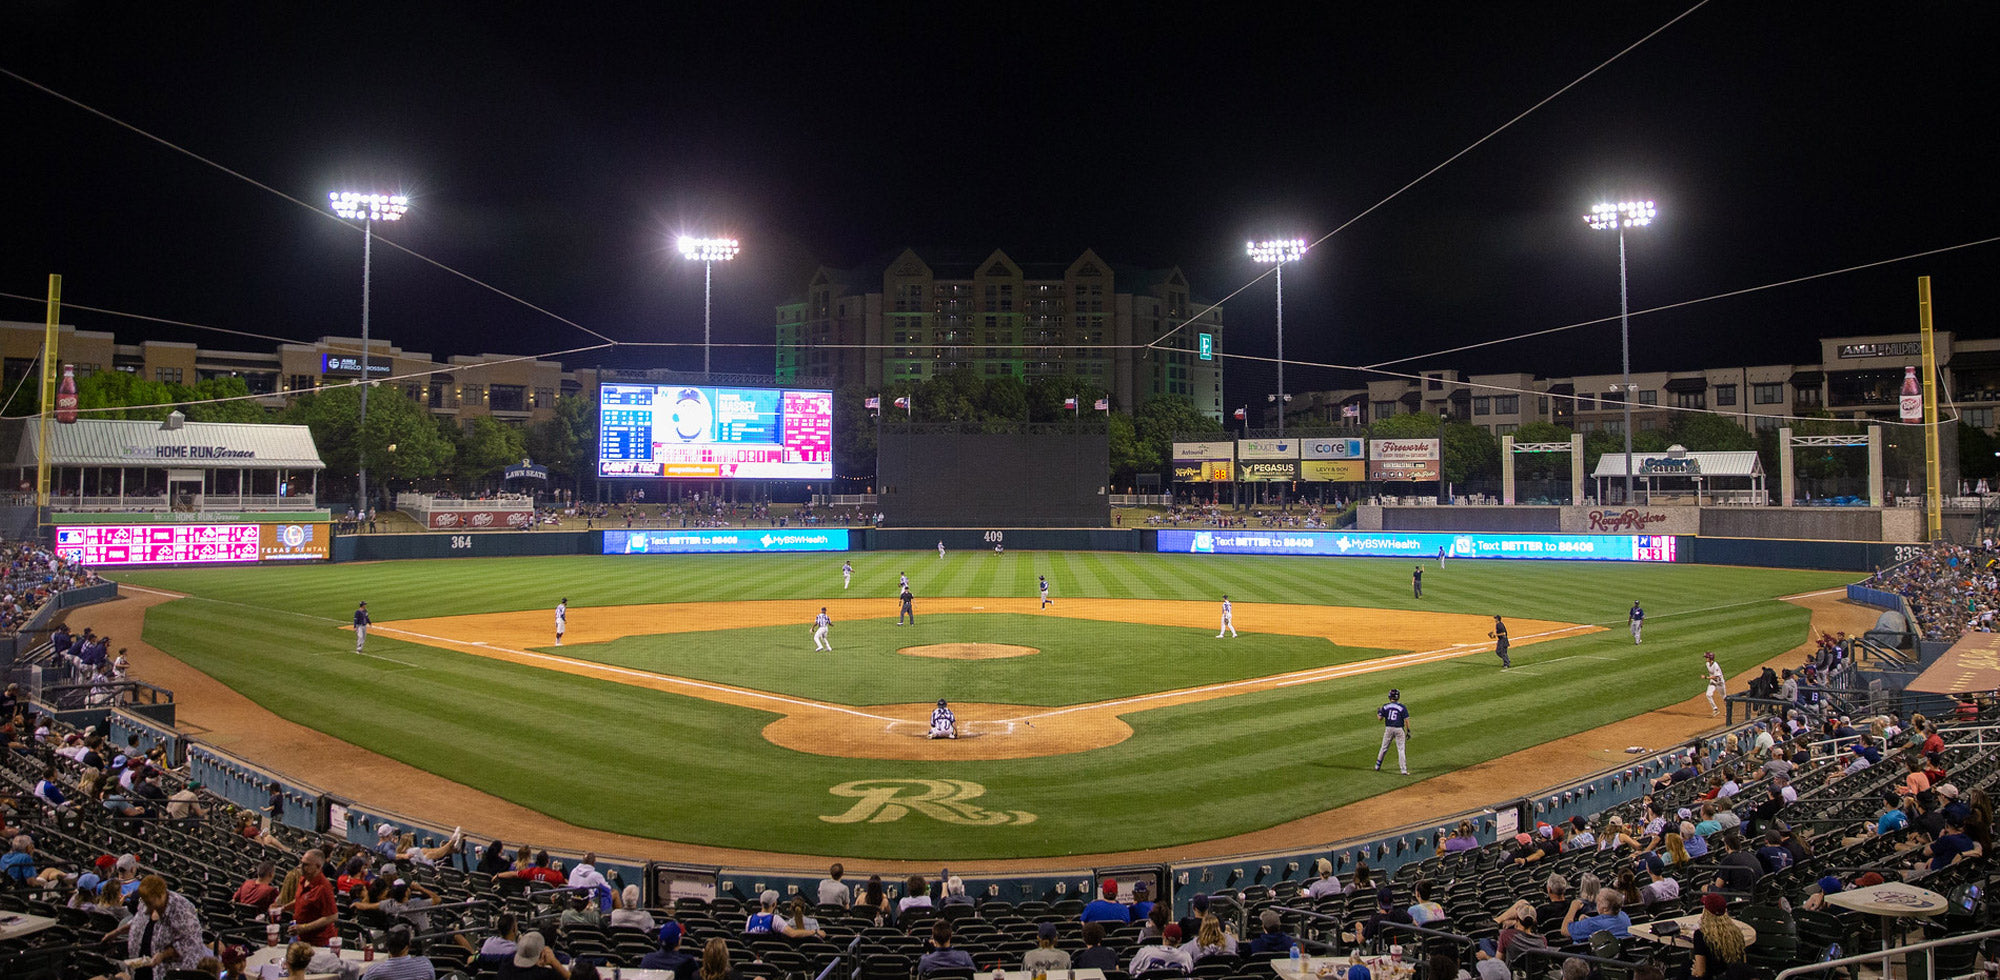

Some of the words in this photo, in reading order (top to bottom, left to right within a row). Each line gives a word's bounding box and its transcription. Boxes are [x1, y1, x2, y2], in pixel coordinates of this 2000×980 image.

[1843, 344, 1877, 354] AMLI
[156, 445, 187, 457] HOME
[190, 446, 213, 458] RUN
[213, 446, 255, 458] Terrace
[1315, 443, 1345, 453] core
[1382, 441, 1429, 452] Fireworks
[1253, 463, 1295, 472] PEGASUS
[505, 470, 524, 479] LAWN
[525, 470, 547, 480] SEATS
[650, 536, 668, 544] Text
[983, 530, 1003, 542] 409
[1215, 536, 1234, 546] Text
[1235, 537, 1271, 547] BETTER
[1272, 538, 1282, 547] to
[451, 535, 472, 549] 364
[1351, 538, 1420, 550] MyBSWHealth
[1478, 540, 1499, 551] Text
[1501, 541, 1543, 552] BETTER
[1545, 542, 1556, 552] to
[1558, 541, 1594, 552] 88408
[1652, 537, 1661, 547] 10
[1894, 545, 1920, 562] 335
[1387, 709, 1398, 720] 16
